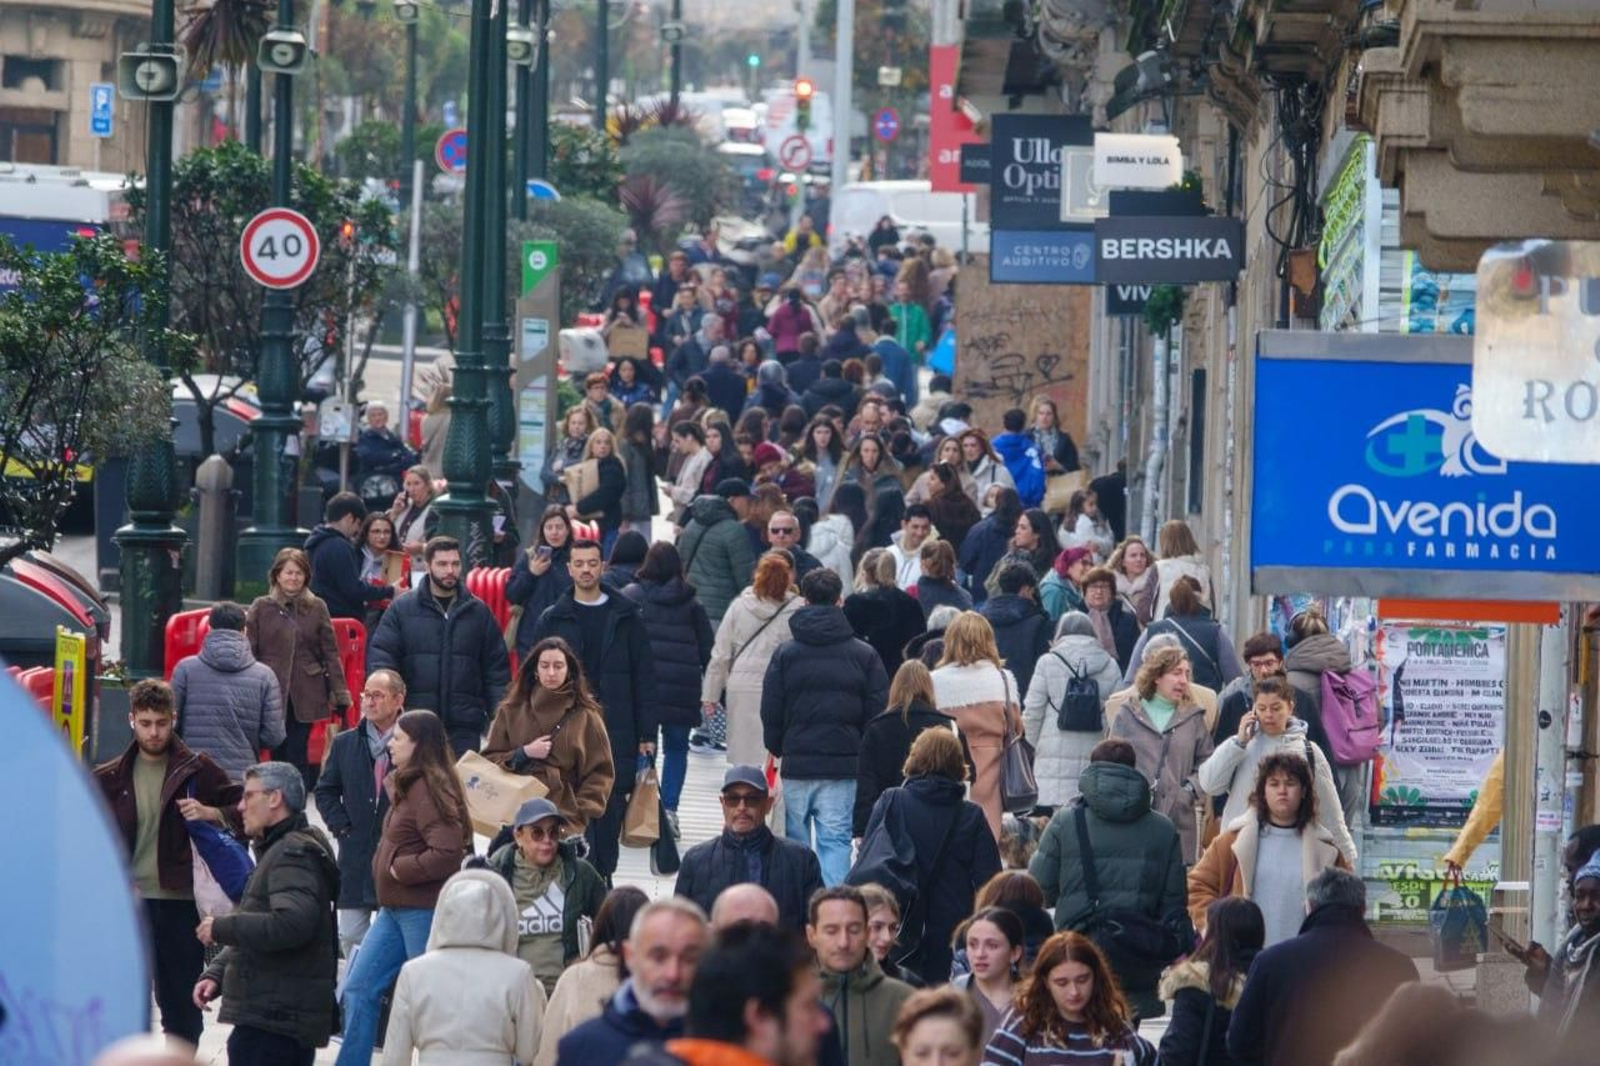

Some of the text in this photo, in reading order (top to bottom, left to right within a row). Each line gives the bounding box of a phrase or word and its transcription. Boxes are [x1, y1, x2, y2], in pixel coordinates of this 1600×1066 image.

[1106, 155, 1170, 165] BIMBA Y LOLA
[257, 233, 303, 261] 40
[1013, 245, 1071, 256] CENTRO
[1101, 238, 1233, 260] BERSHKA
[1001, 256, 1071, 267] AUDITIVO
[517, 915, 565, 934] adid
